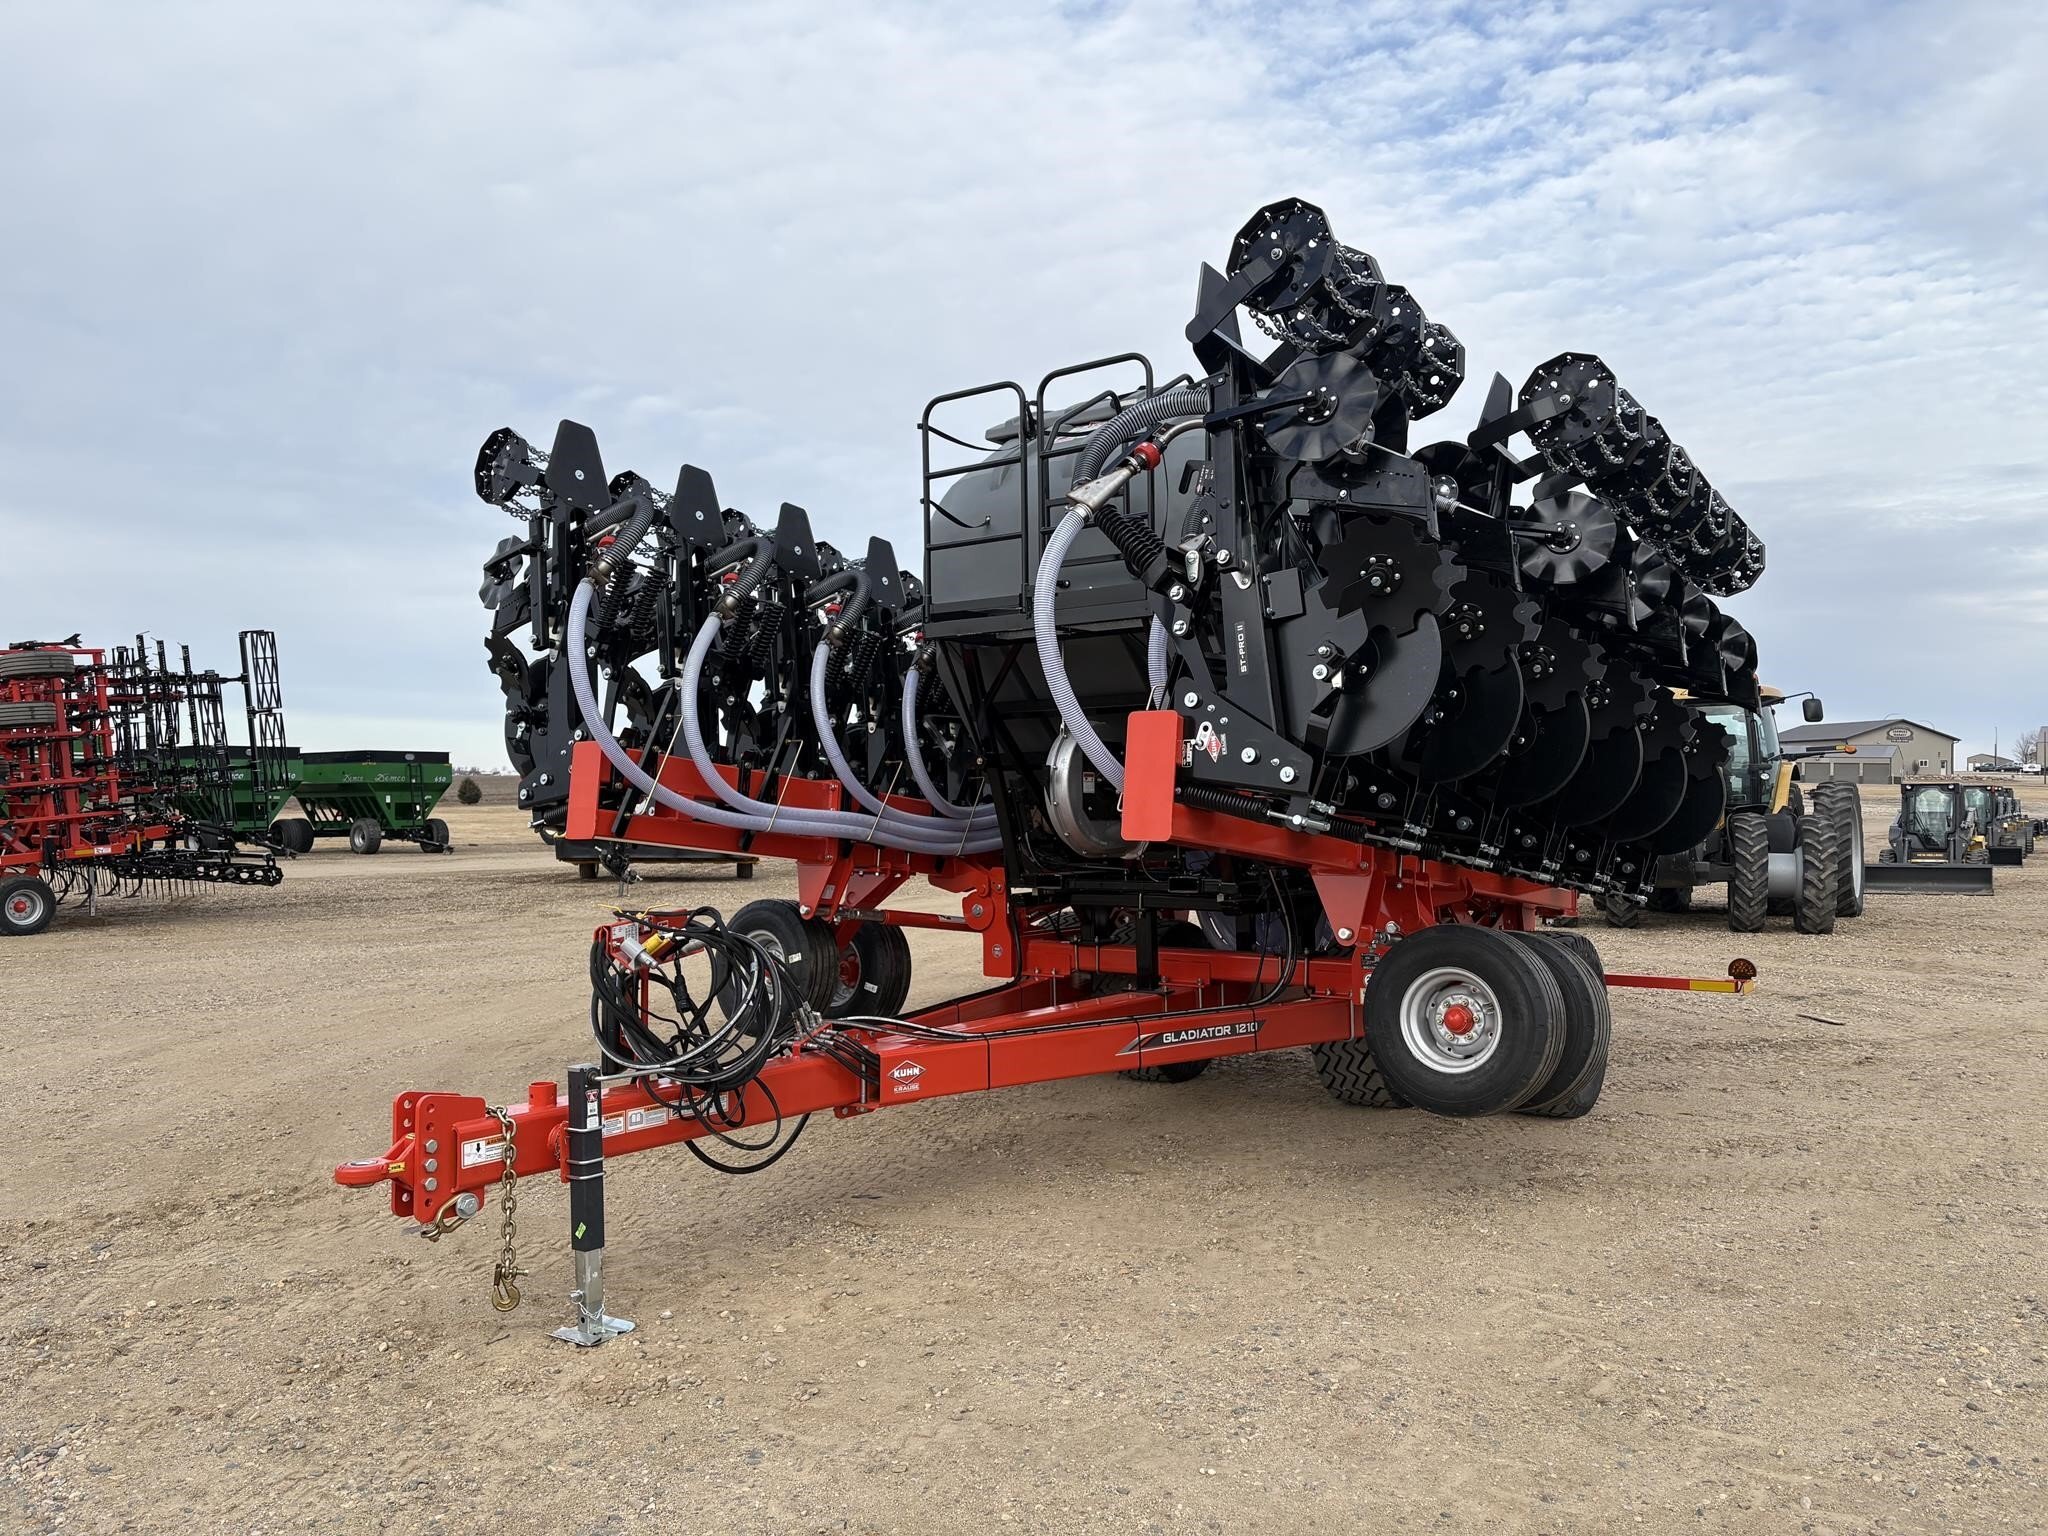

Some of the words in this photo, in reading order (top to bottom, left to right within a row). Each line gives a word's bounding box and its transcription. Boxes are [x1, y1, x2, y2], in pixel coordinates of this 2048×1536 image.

[1237, 633, 1248, 673] ST-PRO
[374, 773, 406, 783] Demco
[1163, 1025, 1231, 1043] GLADIATOR
[1235, 1022, 1258, 1034] 1210
[894, 1067, 920, 1078] KUHN
[893, 1084, 920, 1093] KRAUSE
